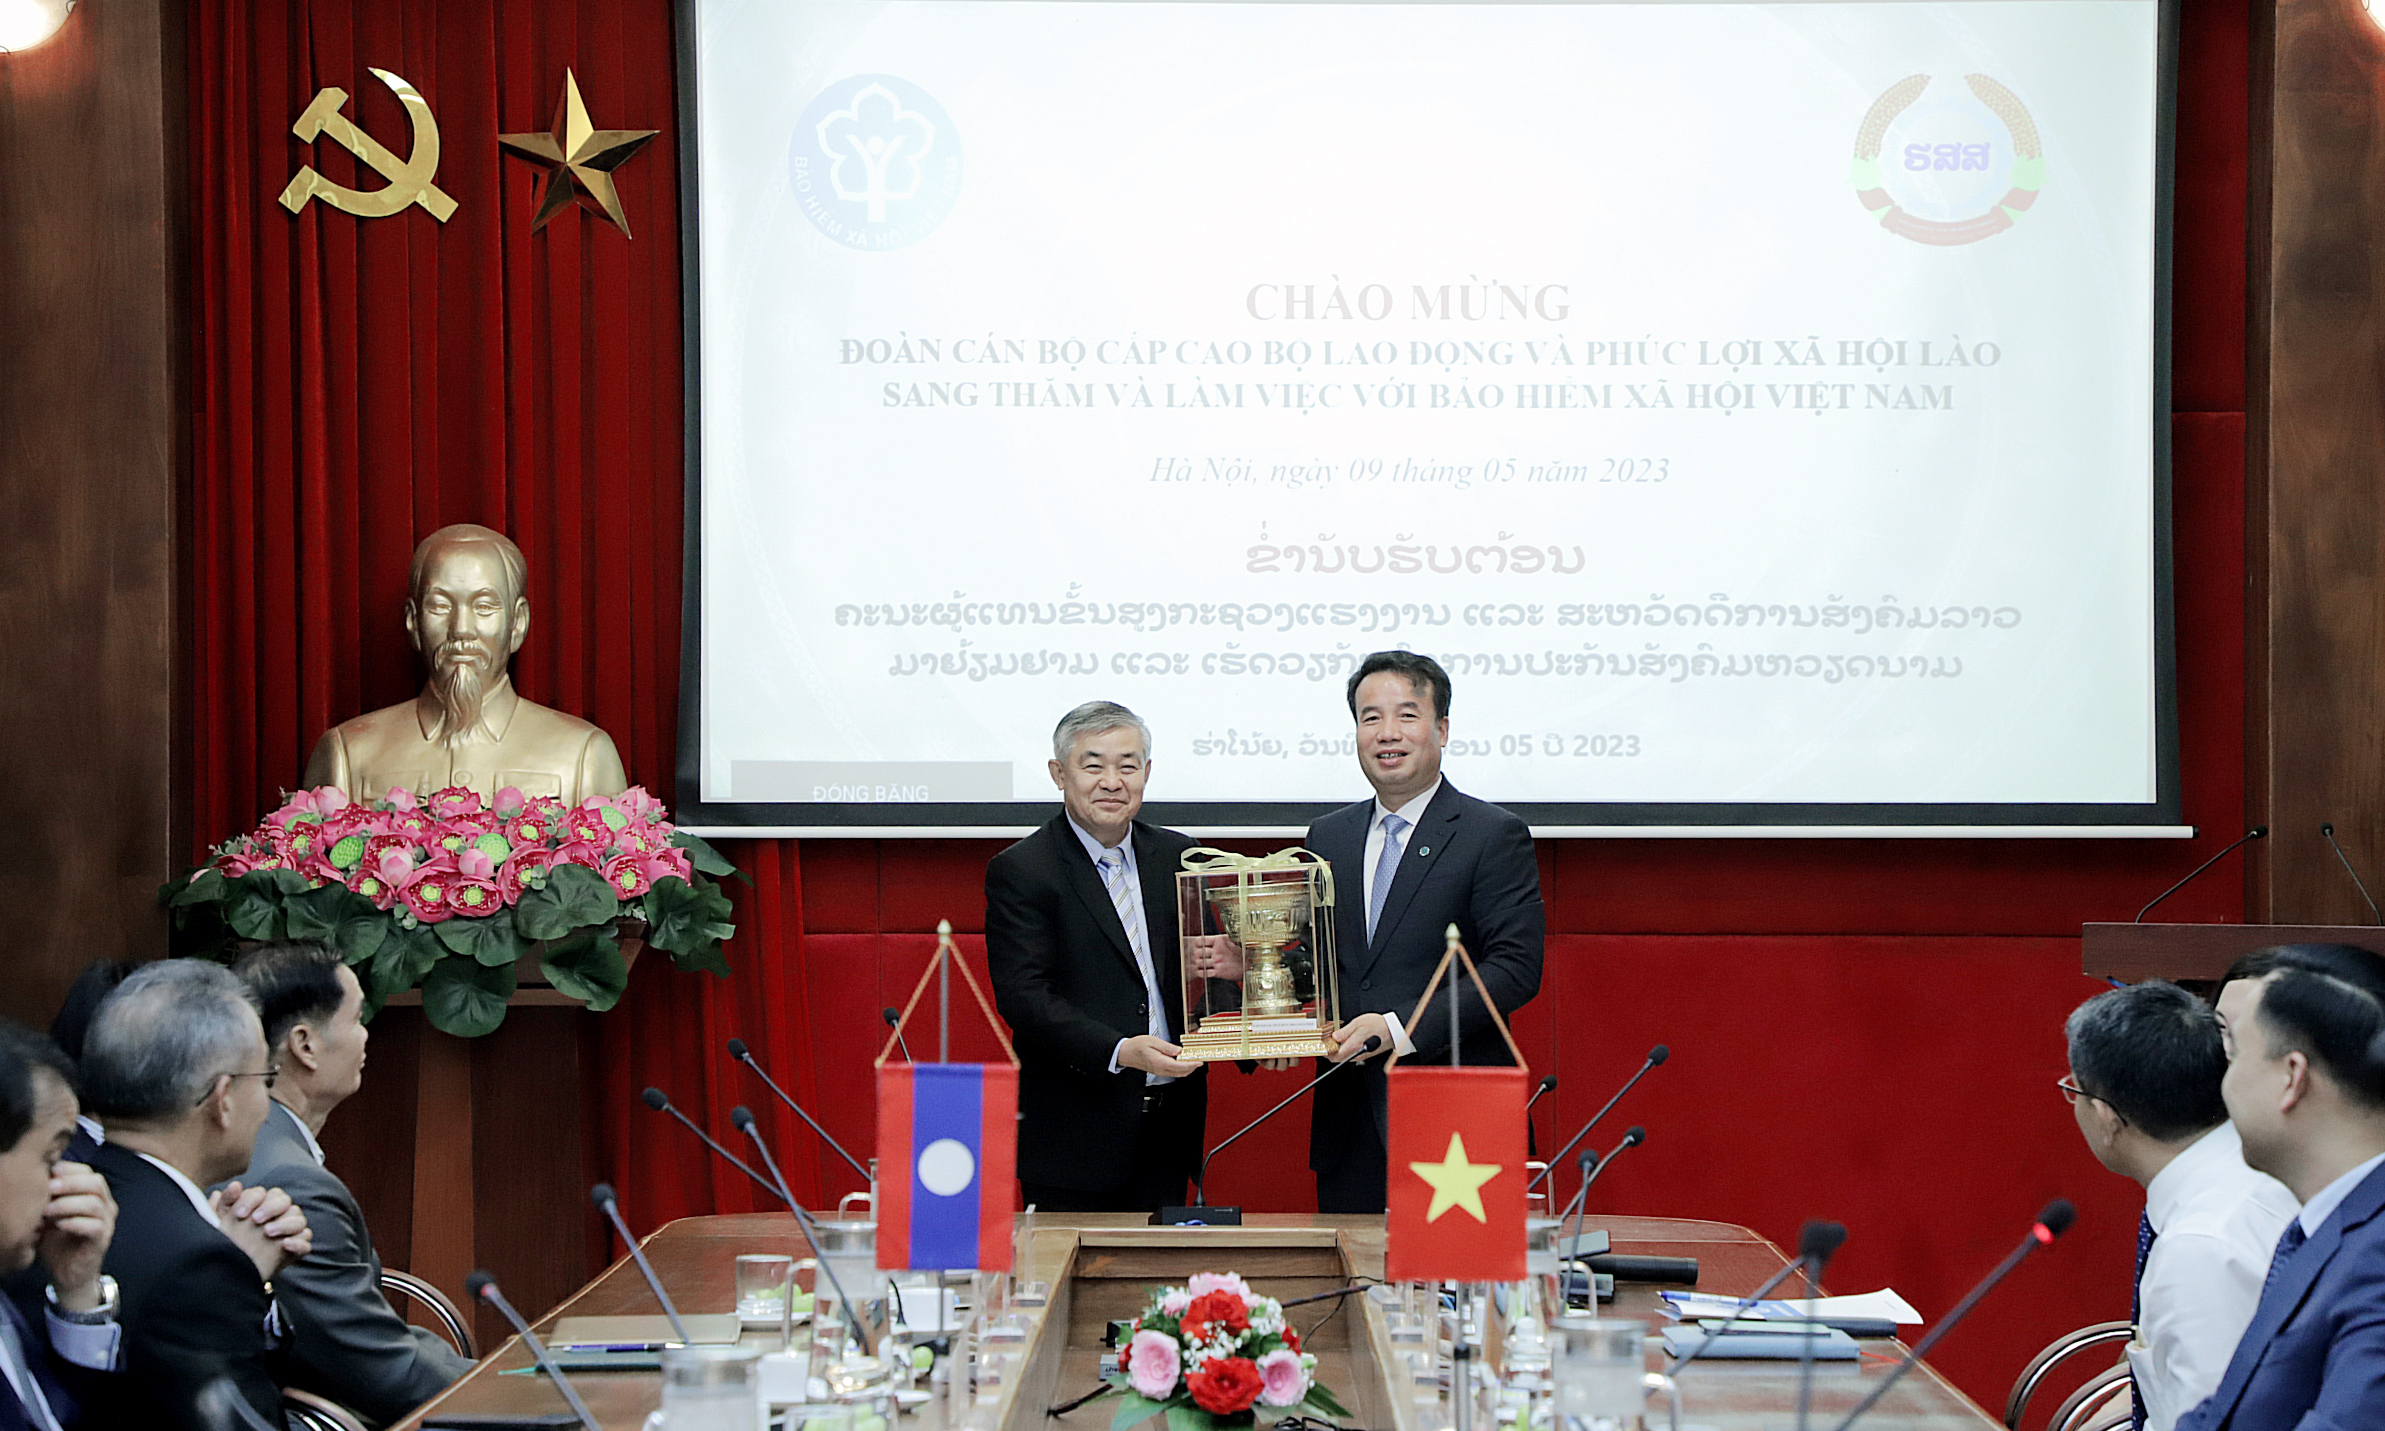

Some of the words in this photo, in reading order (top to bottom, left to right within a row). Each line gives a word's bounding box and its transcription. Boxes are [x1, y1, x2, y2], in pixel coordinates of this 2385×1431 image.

[845, 228, 868, 248] XÃ
[1246, 274, 1393, 321] CHÀO
[1411, 274, 1571, 322] MỪNG
[836, 331, 942, 367] ĐOÀN
[952, 331, 1026, 365] CÁN
[1037, 336, 1087, 372] BỘ
[1175, 340, 1252, 365] CAO
[1261, 338, 1312, 373] BỘ
[1323, 340, 1398, 365] LAO
[1409, 338, 1515, 373] ĐỘNG
[1524, 333, 1576, 366] VÀ
[1585, 333, 1687, 366] PHÚC
[1697, 338, 1764, 373] LỢI
[1773, 335, 1828, 367] XÃ
[1836, 336, 1909, 373] HỘI
[1918, 334, 2002, 367] LÀO
[882, 381, 980, 408] SANG
[988, 376, 1096, 408] THĂM
[1104, 375, 1155, 408] VÀ
[1164, 375, 1245, 408] LÀM
[1254, 379, 1342, 416] VIỆC
[1352, 376, 1418, 408] VỚI
[1428, 376, 1505, 409] BẢO
[1513, 375, 1614, 409] HIỂM
[1623, 378, 1676, 409] XÃ
[1685, 380, 1756, 416] HỘI
[1764, 380, 1856, 416] VIỆT
[1864, 384, 1955, 410] NAM
[1148, 457, 1191, 483] Hà
[1200, 457, 1258, 487] Nội,
[1270, 457, 1339, 490] ngày
[1349, 457, 1384, 483] 09
[1392, 456, 1473, 491] tháng
[1483, 457, 1518, 483] 05
[1527, 459, 1588, 483] năm
[1598, 457, 1670, 483] 2023
[1462, 603, 1545, 626] ແລະ
[1110, 651, 1190, 675] ແລະ
[1499, 733, 1533, 756] 05
[1573, 733, 1642, 757] 2023
